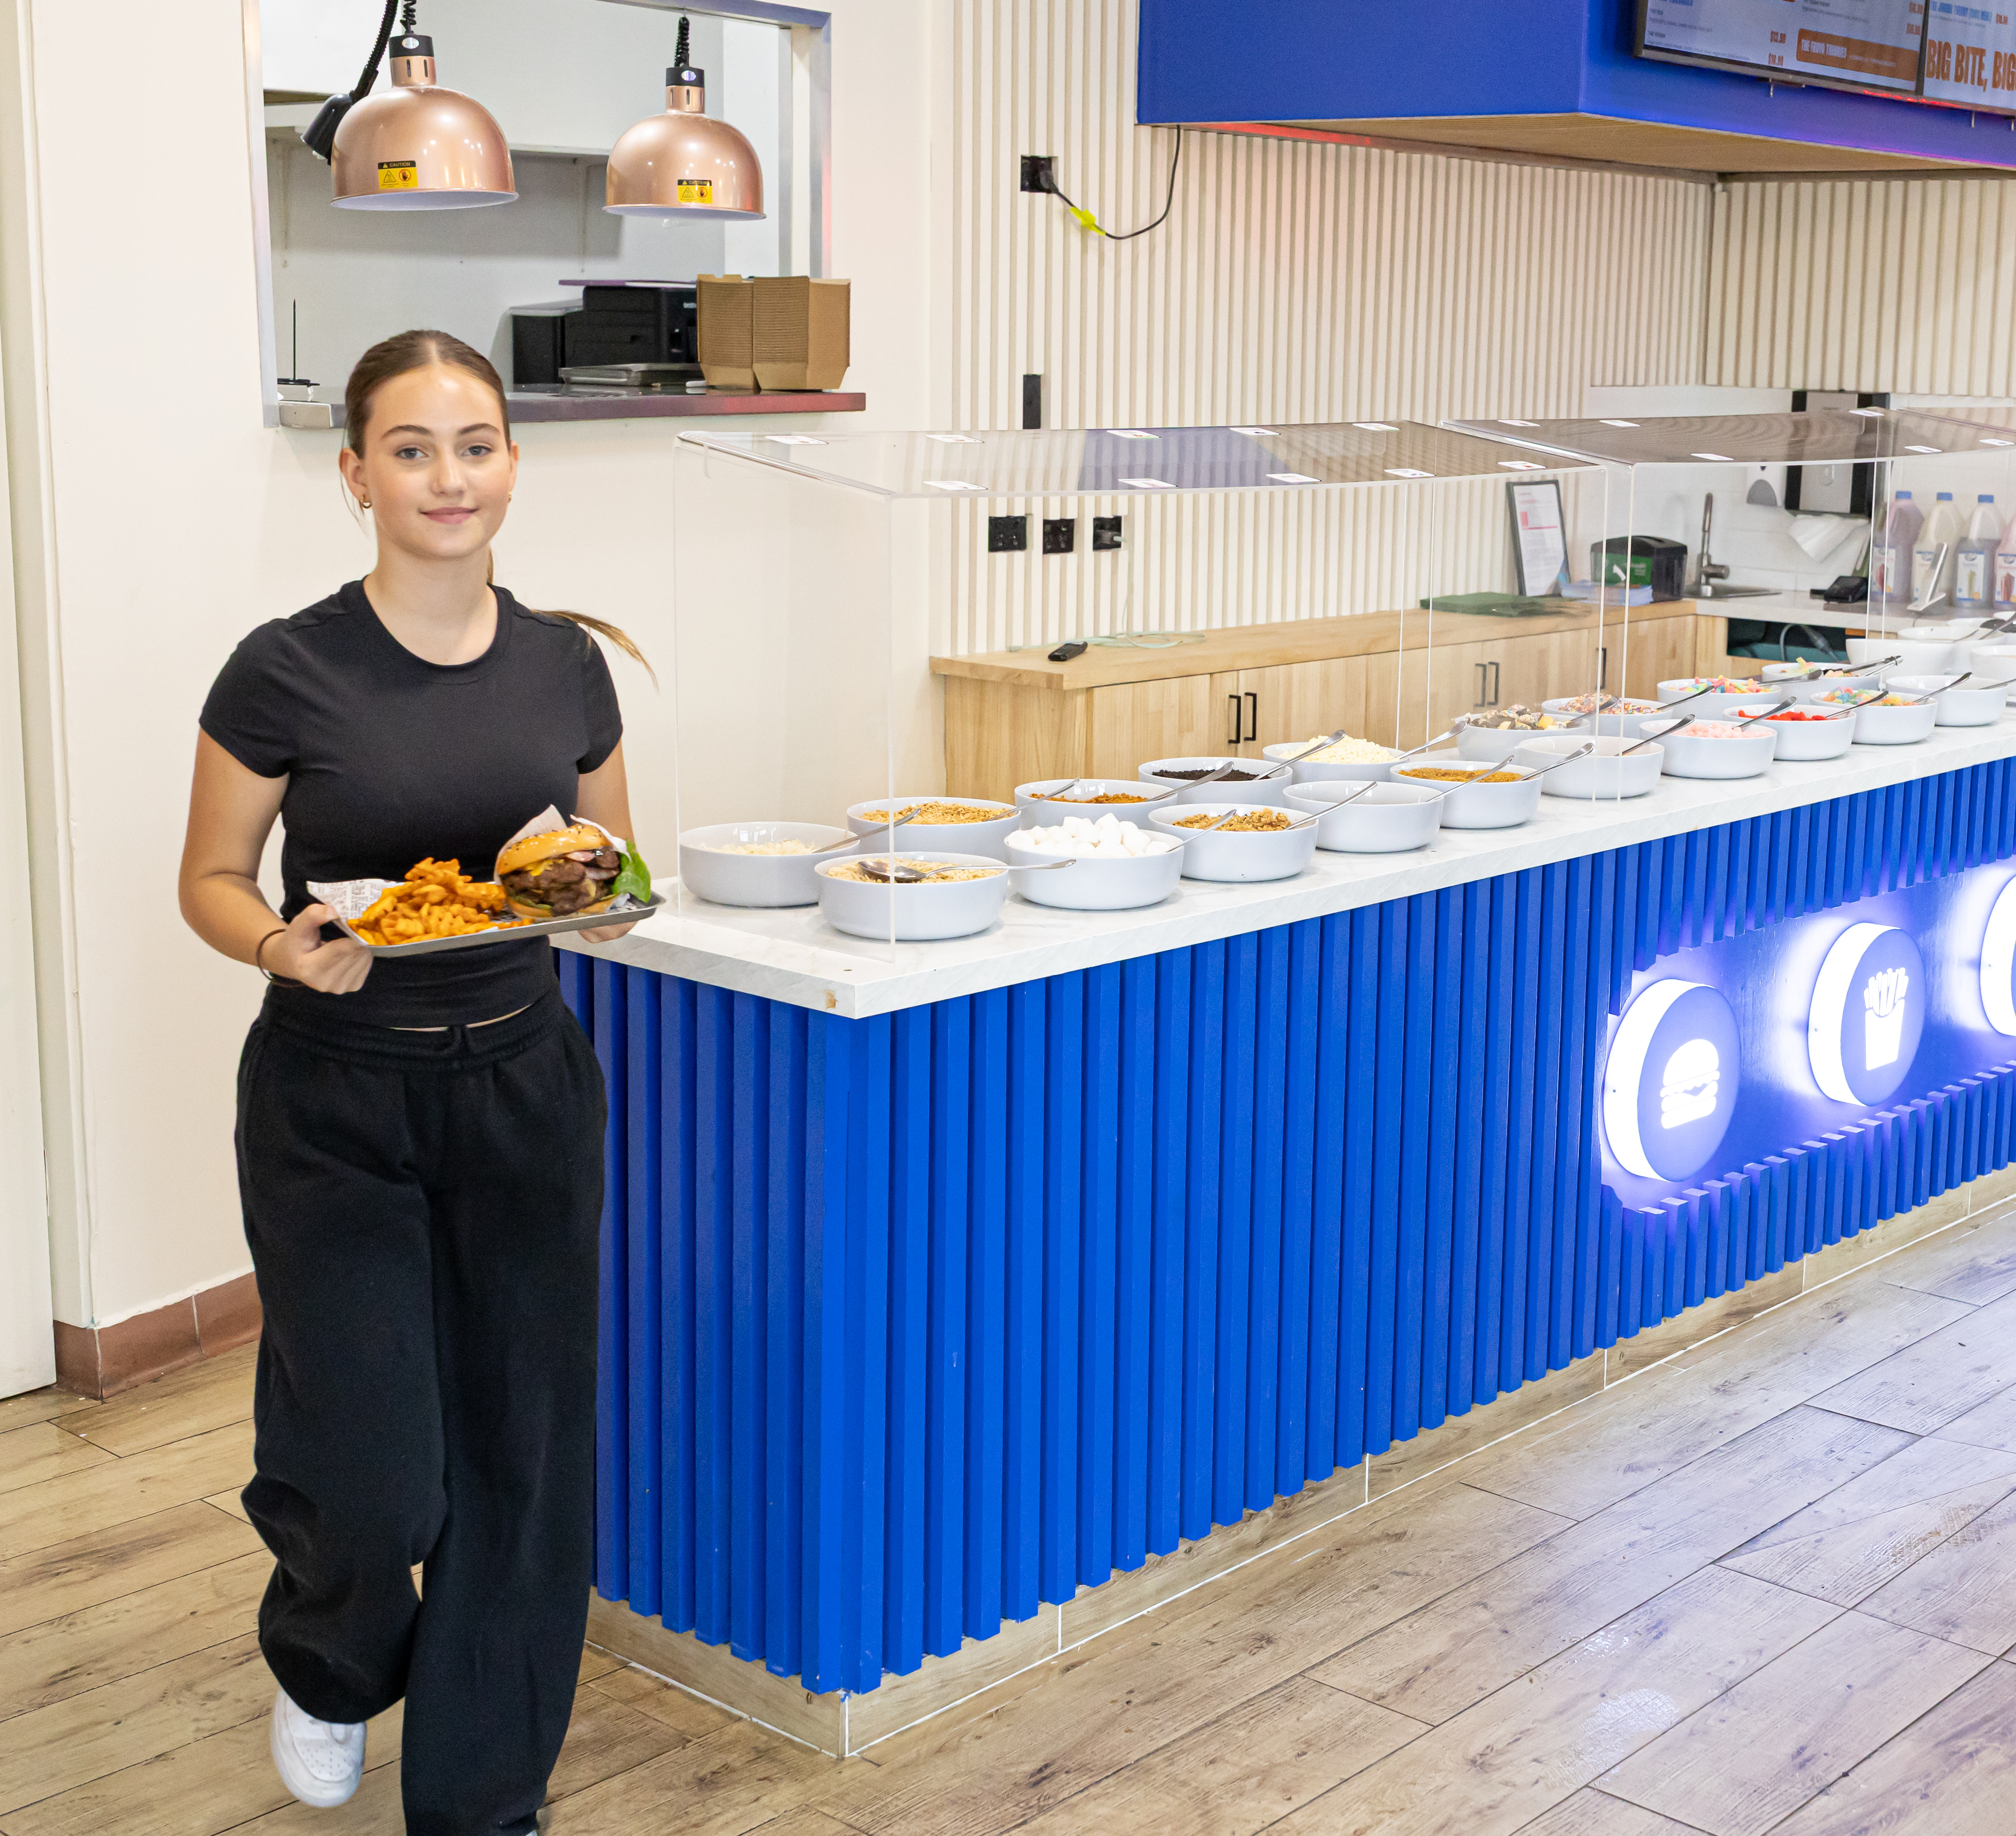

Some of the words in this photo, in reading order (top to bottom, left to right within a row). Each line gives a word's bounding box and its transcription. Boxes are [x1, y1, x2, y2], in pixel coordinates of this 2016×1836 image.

[1926, 39, 1952, 81] BIG
[1954, 44, 1988, 92] BITE,
[1991, 51, 2016, 91] BIG
